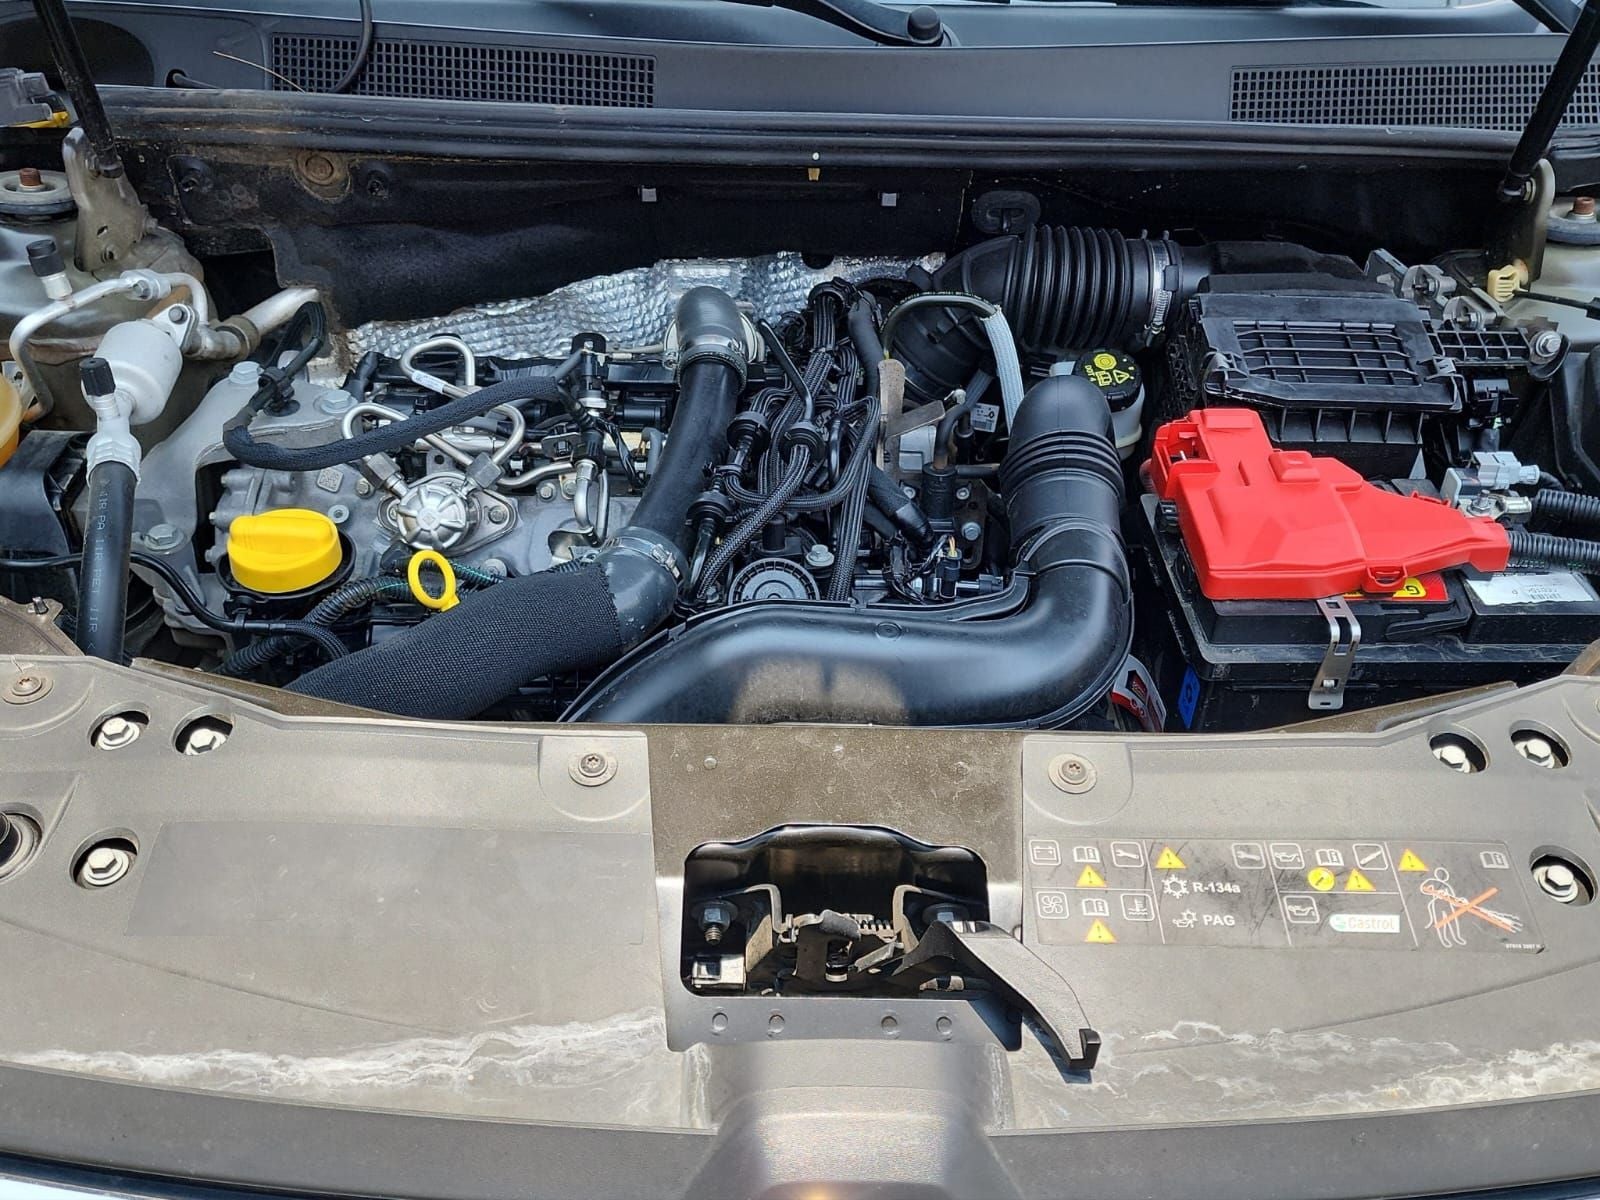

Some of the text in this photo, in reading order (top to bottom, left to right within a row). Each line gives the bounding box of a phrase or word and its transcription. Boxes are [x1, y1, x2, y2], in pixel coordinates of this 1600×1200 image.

[1085, 365, 1095, 376] DOT
[97, 515, 106, 530] PA
[1193, 882, 1241, 893] R-134a
[1203, 914, 1235, 926] PAG
[1348, 917, 1395, 930] Castrol
